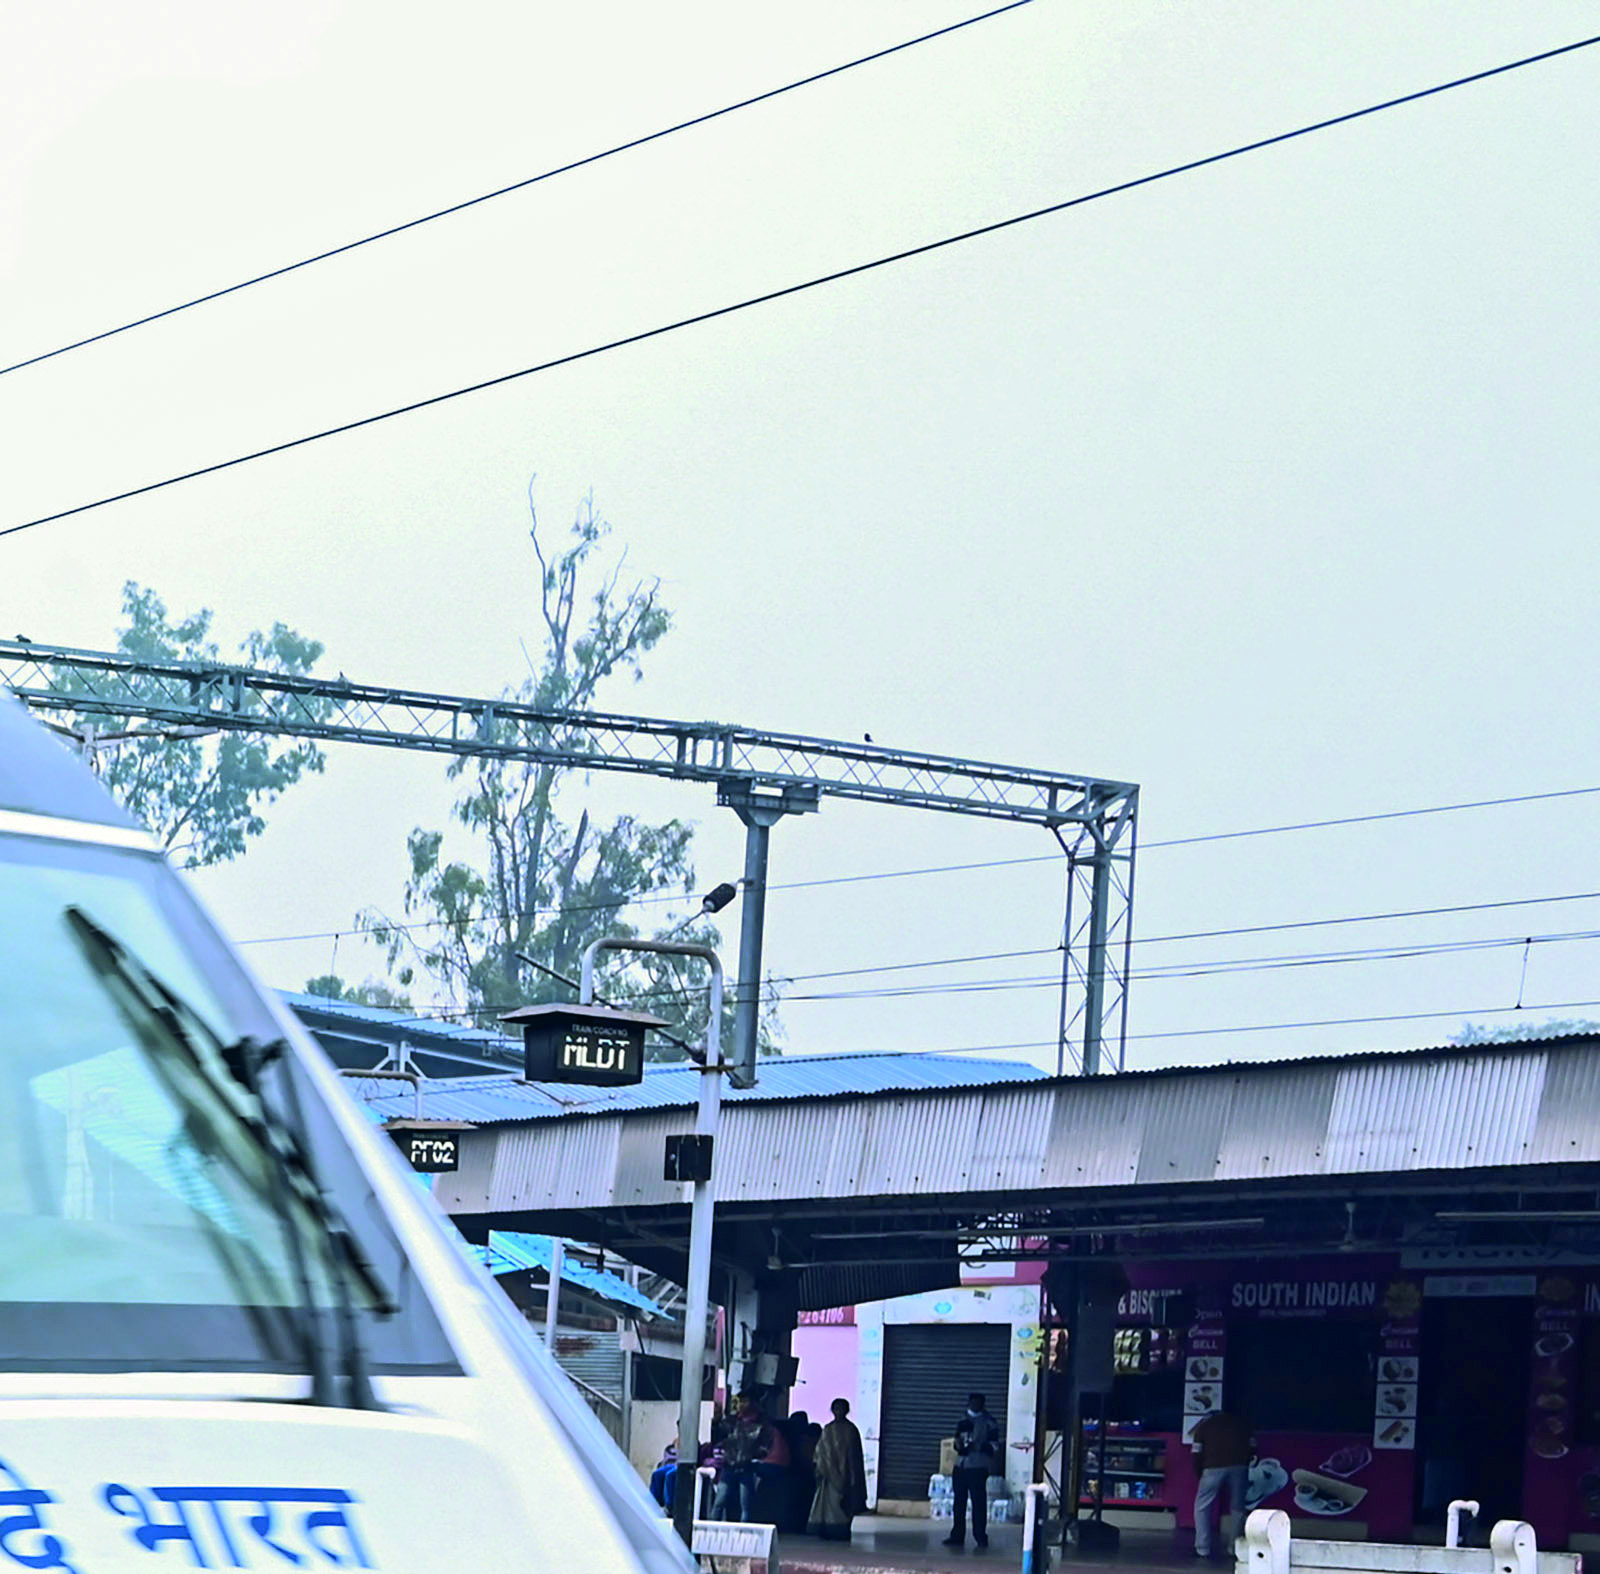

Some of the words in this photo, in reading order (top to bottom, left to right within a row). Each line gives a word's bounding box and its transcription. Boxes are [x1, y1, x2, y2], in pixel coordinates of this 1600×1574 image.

[563, 1035, 630, 1071] MLDT
[410, 1139, 455, 1164] PF02
[1117, 1294, 1127, 1315] &
[1232, 1281, 1298, 1307] SOUTH
[1305, 1281, 1376, 1306] INDIAN
[101, 1480, 374, 1571] भारत
